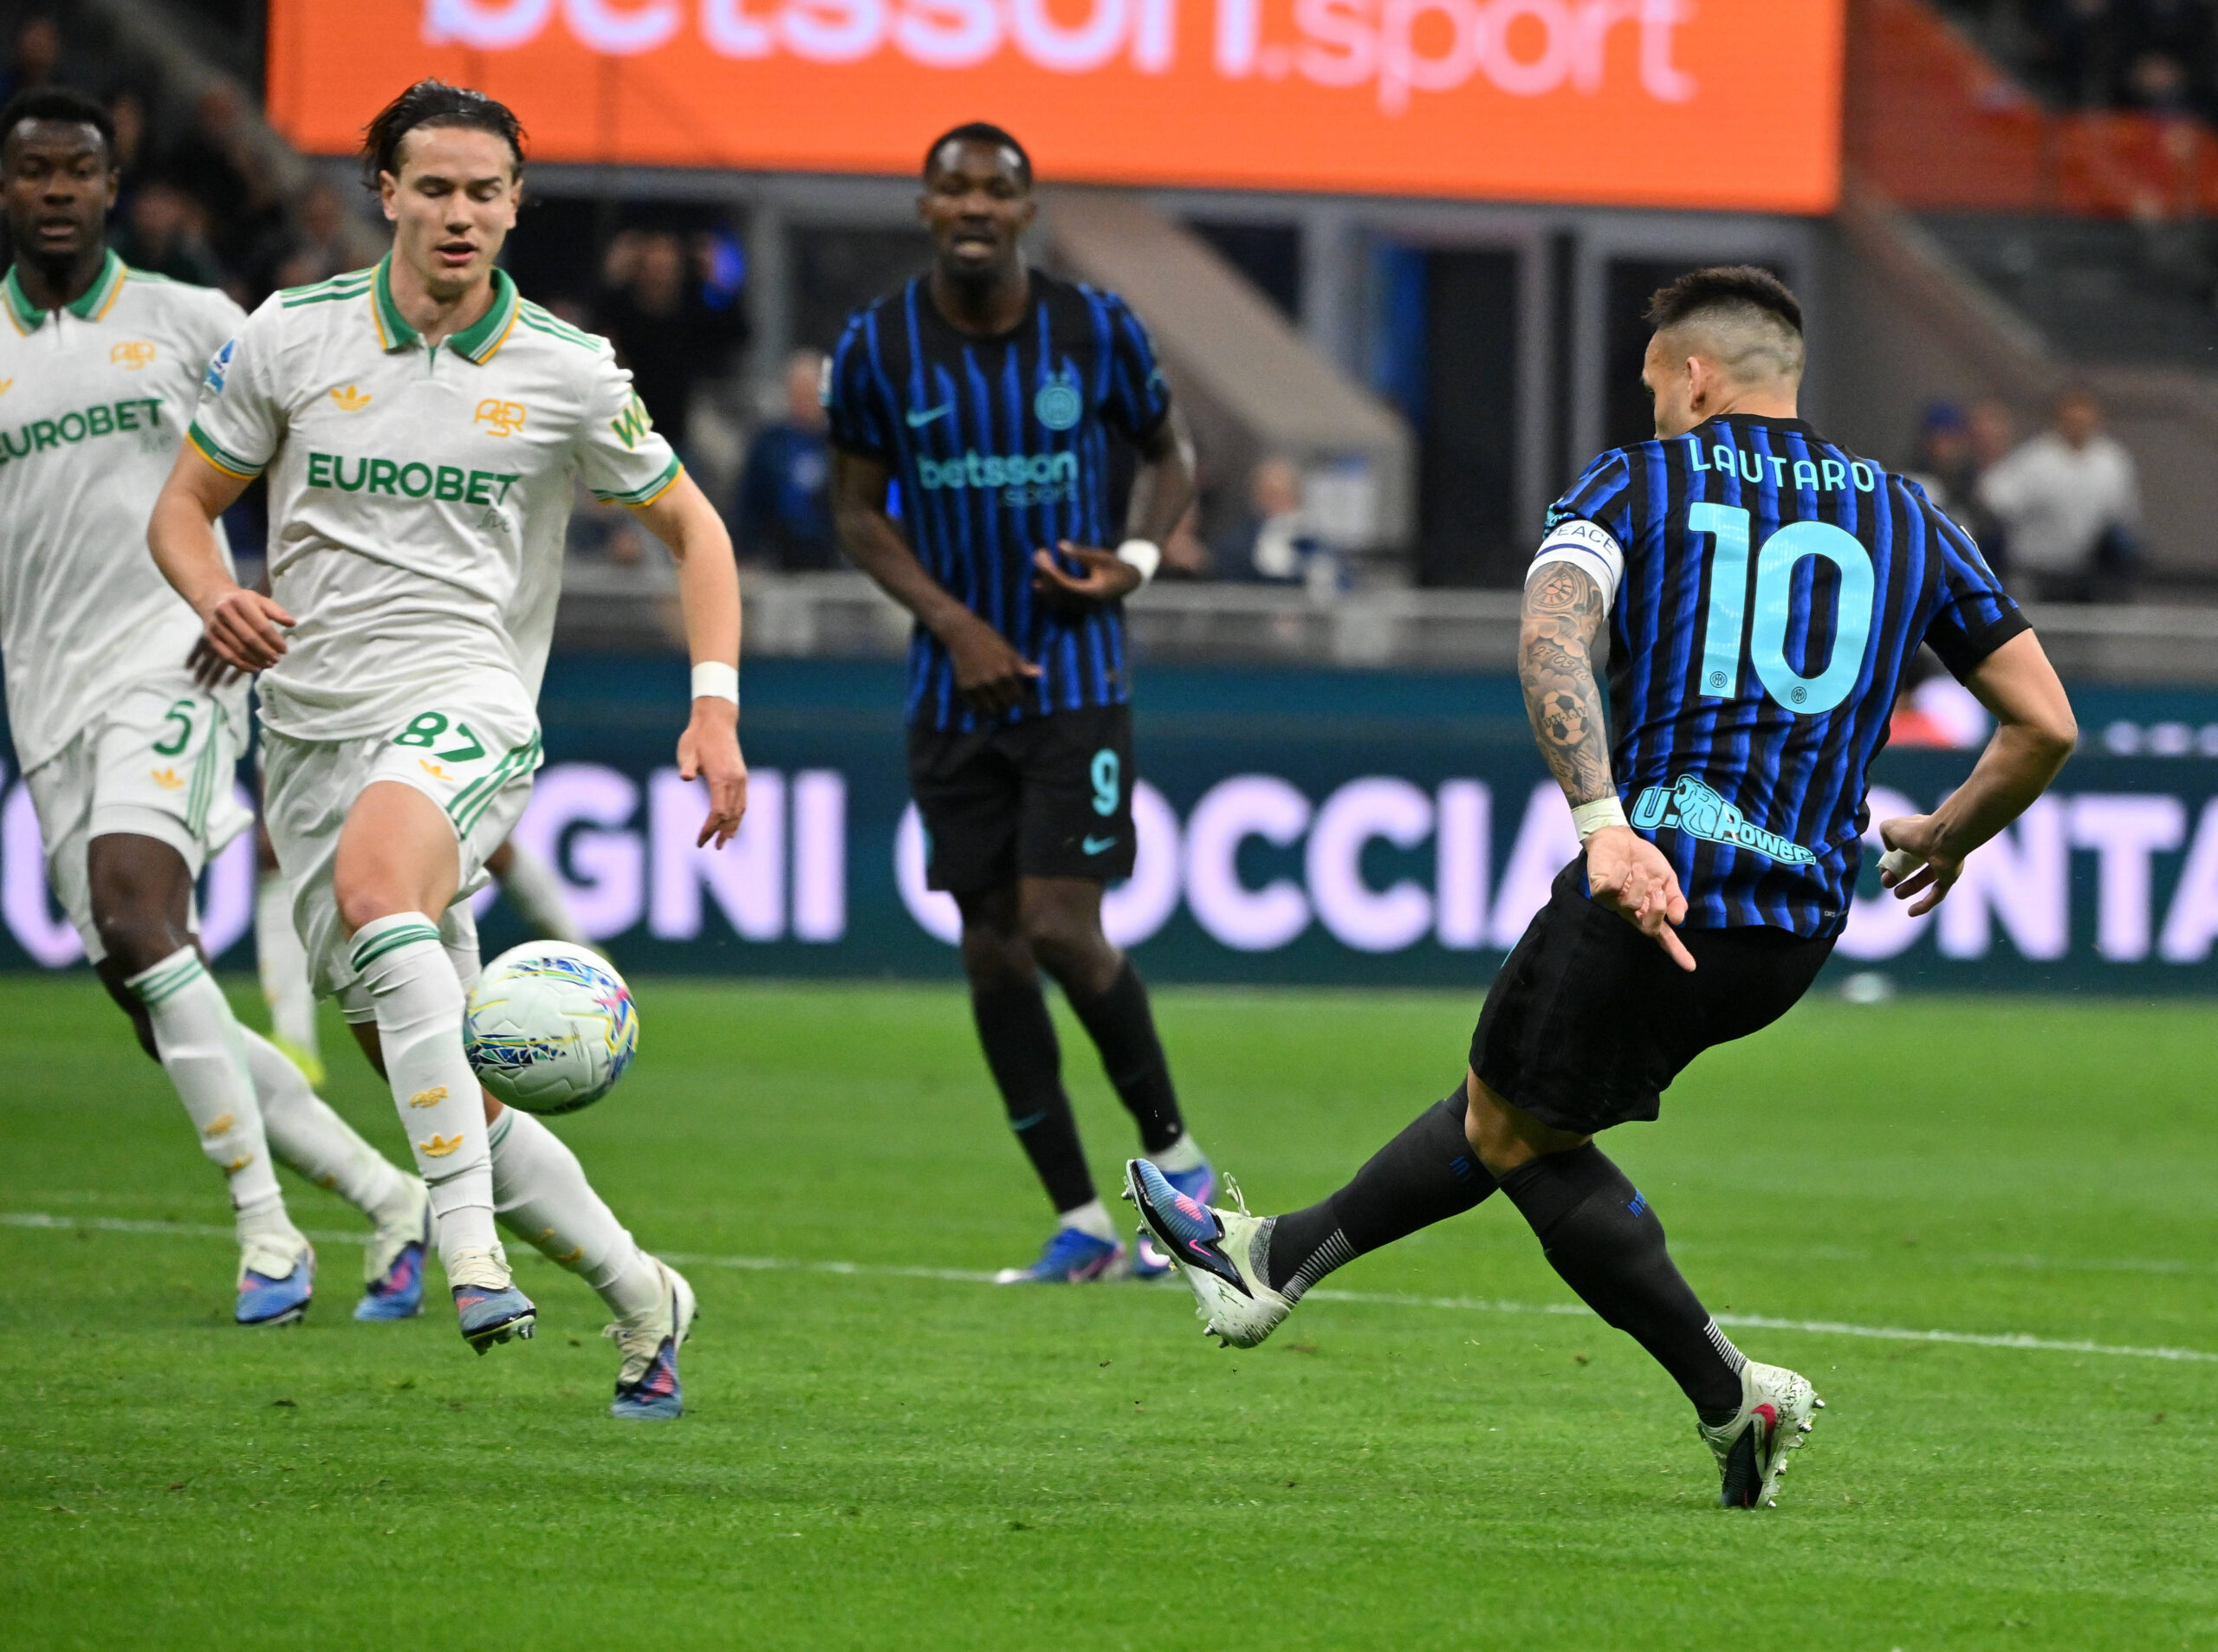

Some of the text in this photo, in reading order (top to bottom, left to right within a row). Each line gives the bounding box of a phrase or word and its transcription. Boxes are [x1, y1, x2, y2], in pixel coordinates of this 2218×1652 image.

[0, 398, 165, 465] UROBET
[308, 451, 522, 507] EUROBET
[917, 448, 1080, 489] betsson
[1689, 438, 1875, 493] LAUTARO
[1553, 525, 1616, 555] EACE
[1689, 502, 1875, 715] 10
[152, 700, 196, 755] 5
[392, 710, 486, 763] 87
[1091, 748, 1119, 816] 9
[482, 762, 848, 943] GNI
